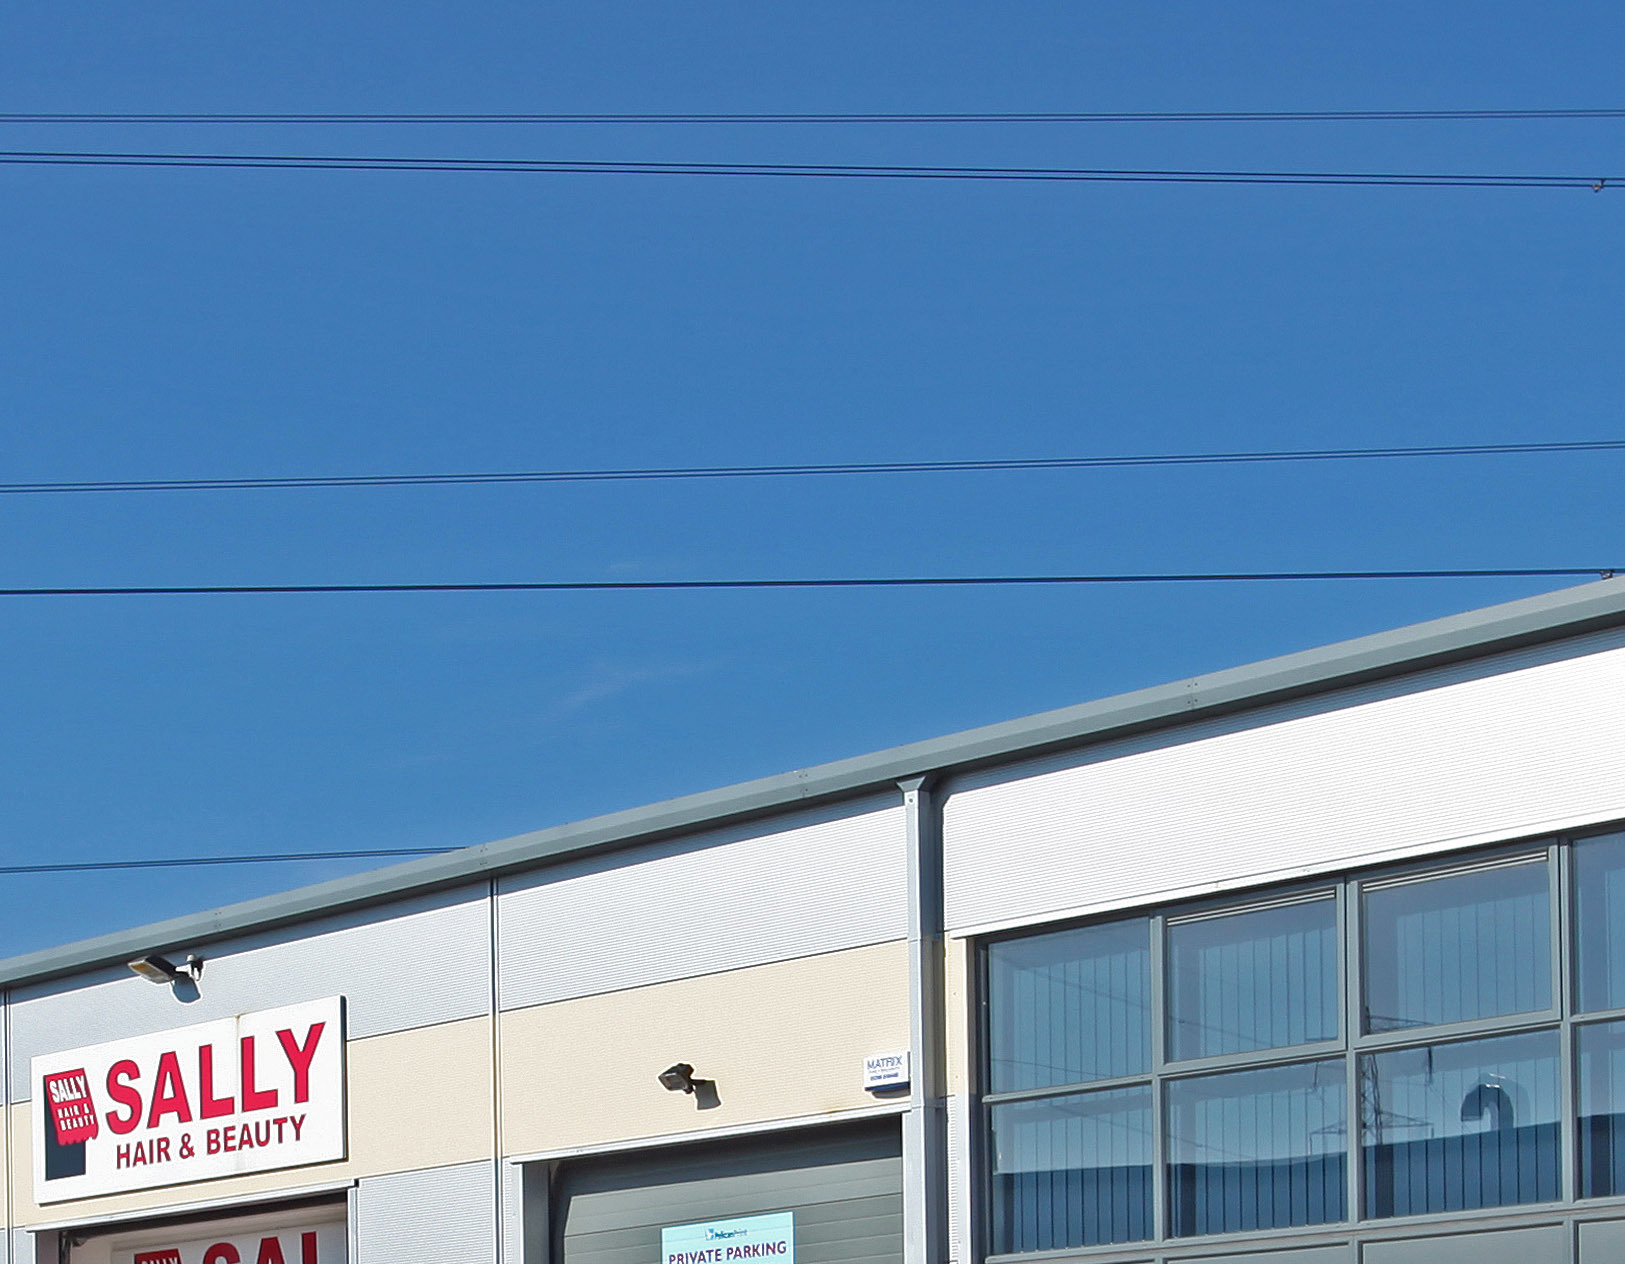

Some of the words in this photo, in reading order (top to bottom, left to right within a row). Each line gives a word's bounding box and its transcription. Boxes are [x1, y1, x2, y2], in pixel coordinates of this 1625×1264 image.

[49, 1075, 87, 1104] SALLY
[105, 1021, 326, 1135] SALLY
[57, 1105, 80, 1119] HAIR
[60, 1114, 95, 1131] BEAUTY
[116, 1137, 171, 1170] HAIR
[179, 1133, 195, 1160] &
[206, 1114, 306, 1156] BEAUTY
[726, 1240, 787, 1261] PARKING
